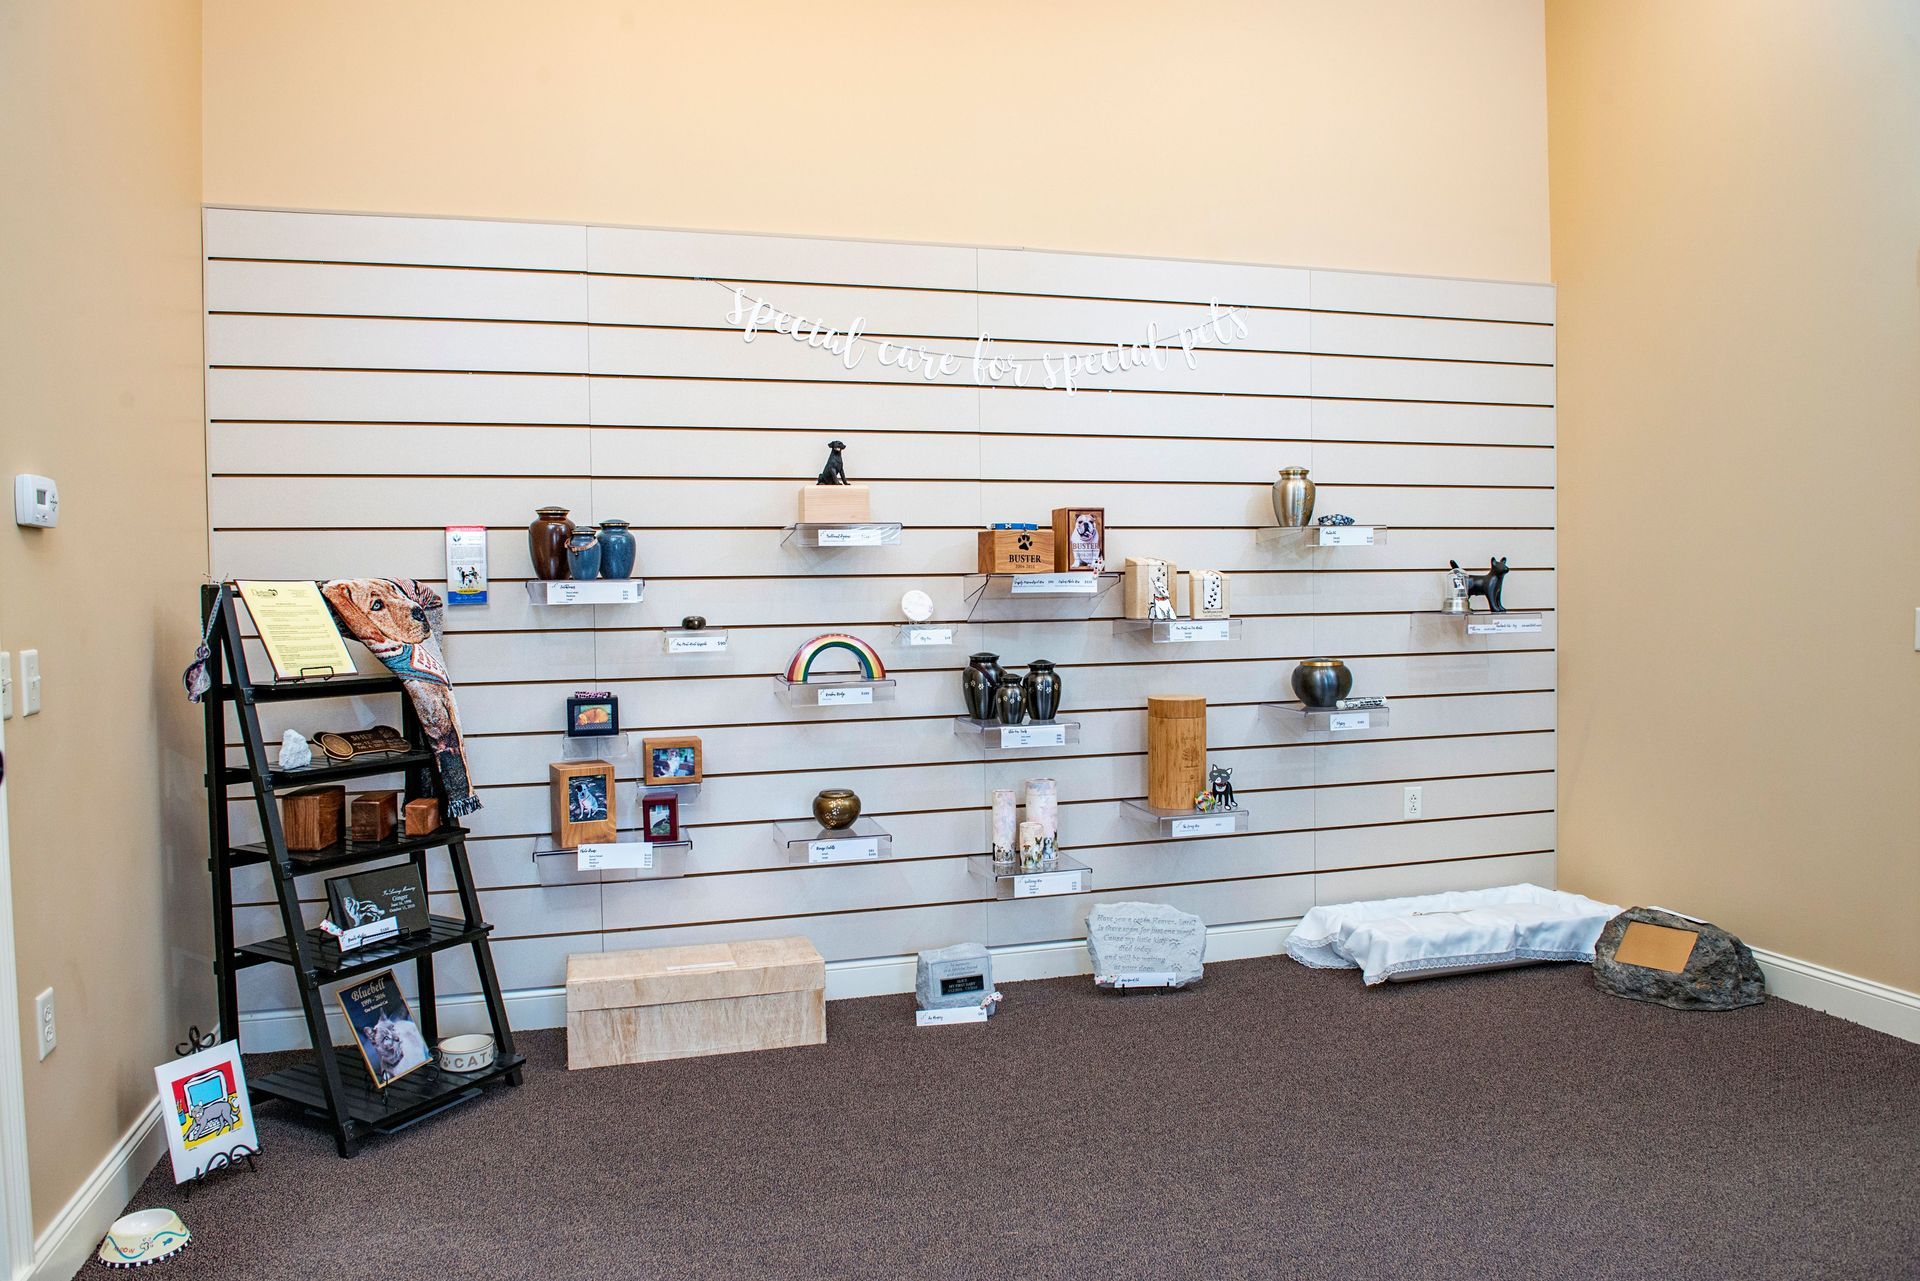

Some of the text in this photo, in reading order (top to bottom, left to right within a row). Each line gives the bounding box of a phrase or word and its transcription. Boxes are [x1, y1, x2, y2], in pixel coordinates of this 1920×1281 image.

[725, 287, 1250, 397] special care for special pets
[1008, 554, 1042, 562] BUSTER
[1140, 926, 1151, 935] for
[351, 977, 386, 1002] Bluebell
[454, 1053, 487, 1069] CAT
